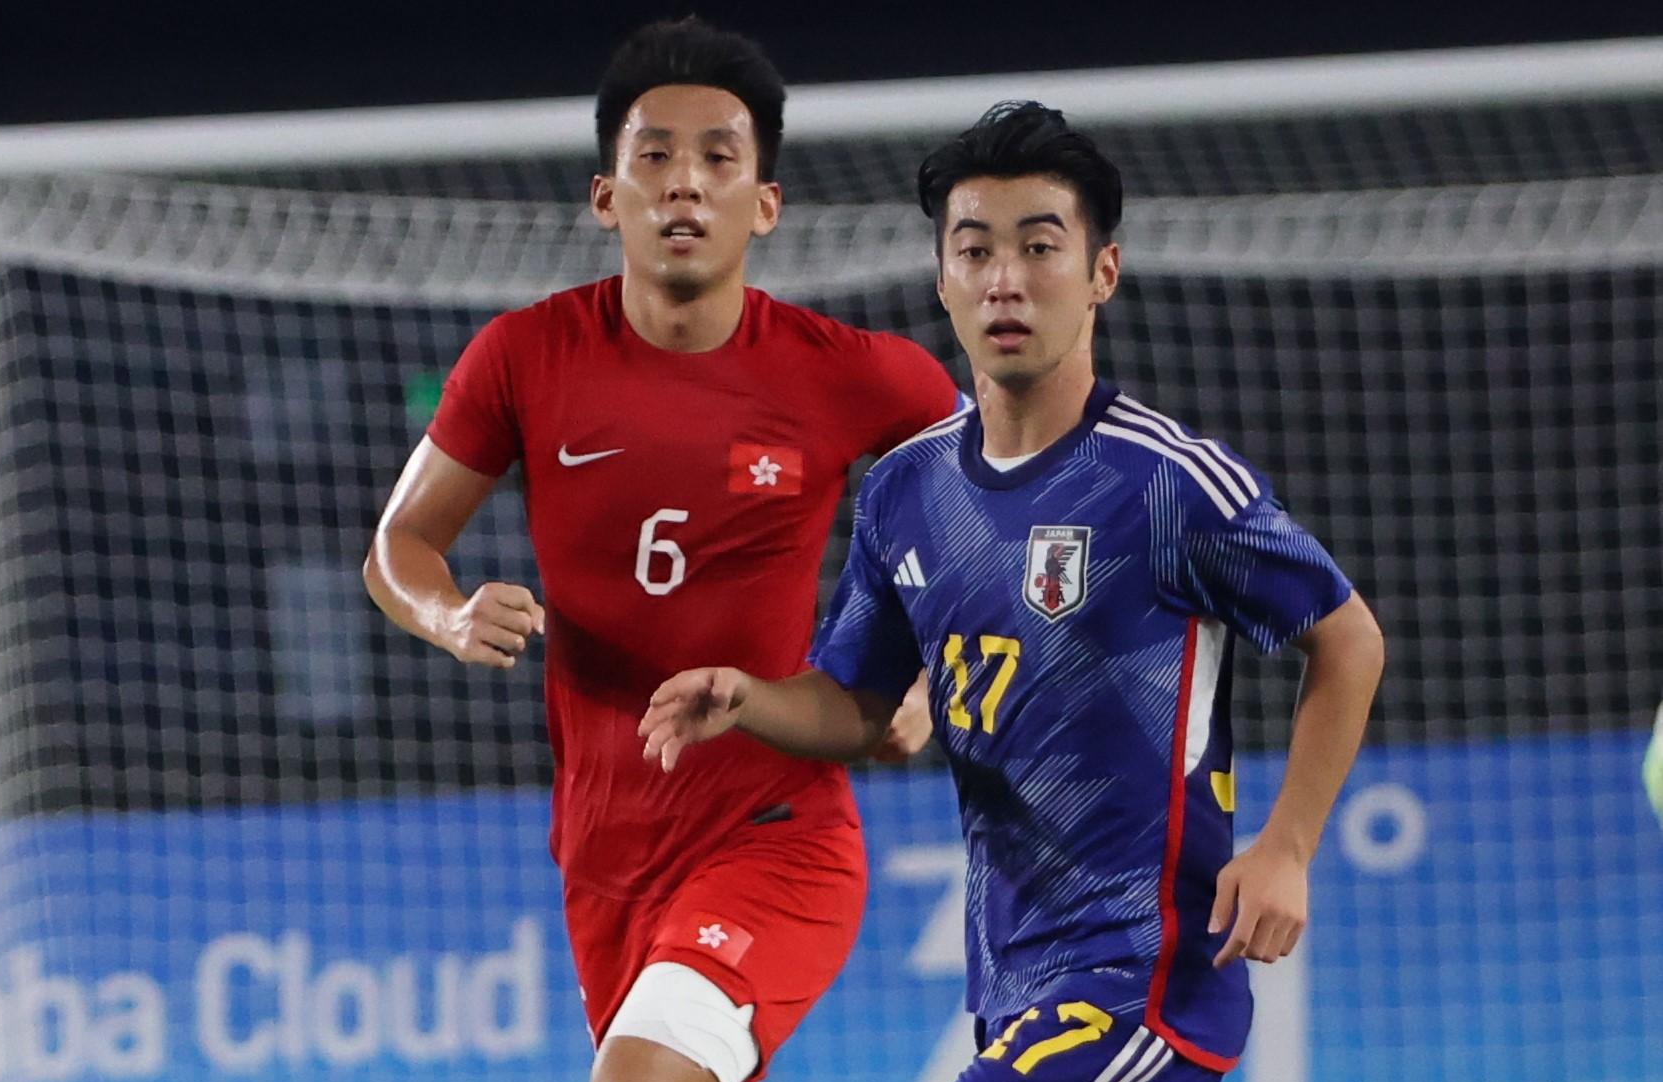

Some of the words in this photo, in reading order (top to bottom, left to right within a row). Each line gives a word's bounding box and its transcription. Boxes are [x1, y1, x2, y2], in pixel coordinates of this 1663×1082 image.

[635, 508, 689, 595] 6
[1045, 530, 1074, 539] JAPAN
[944, 634, 1020, 735] 17
[196, 914, 542, 1072] Cloud
[979, 1001, 1113, 1075] 17
